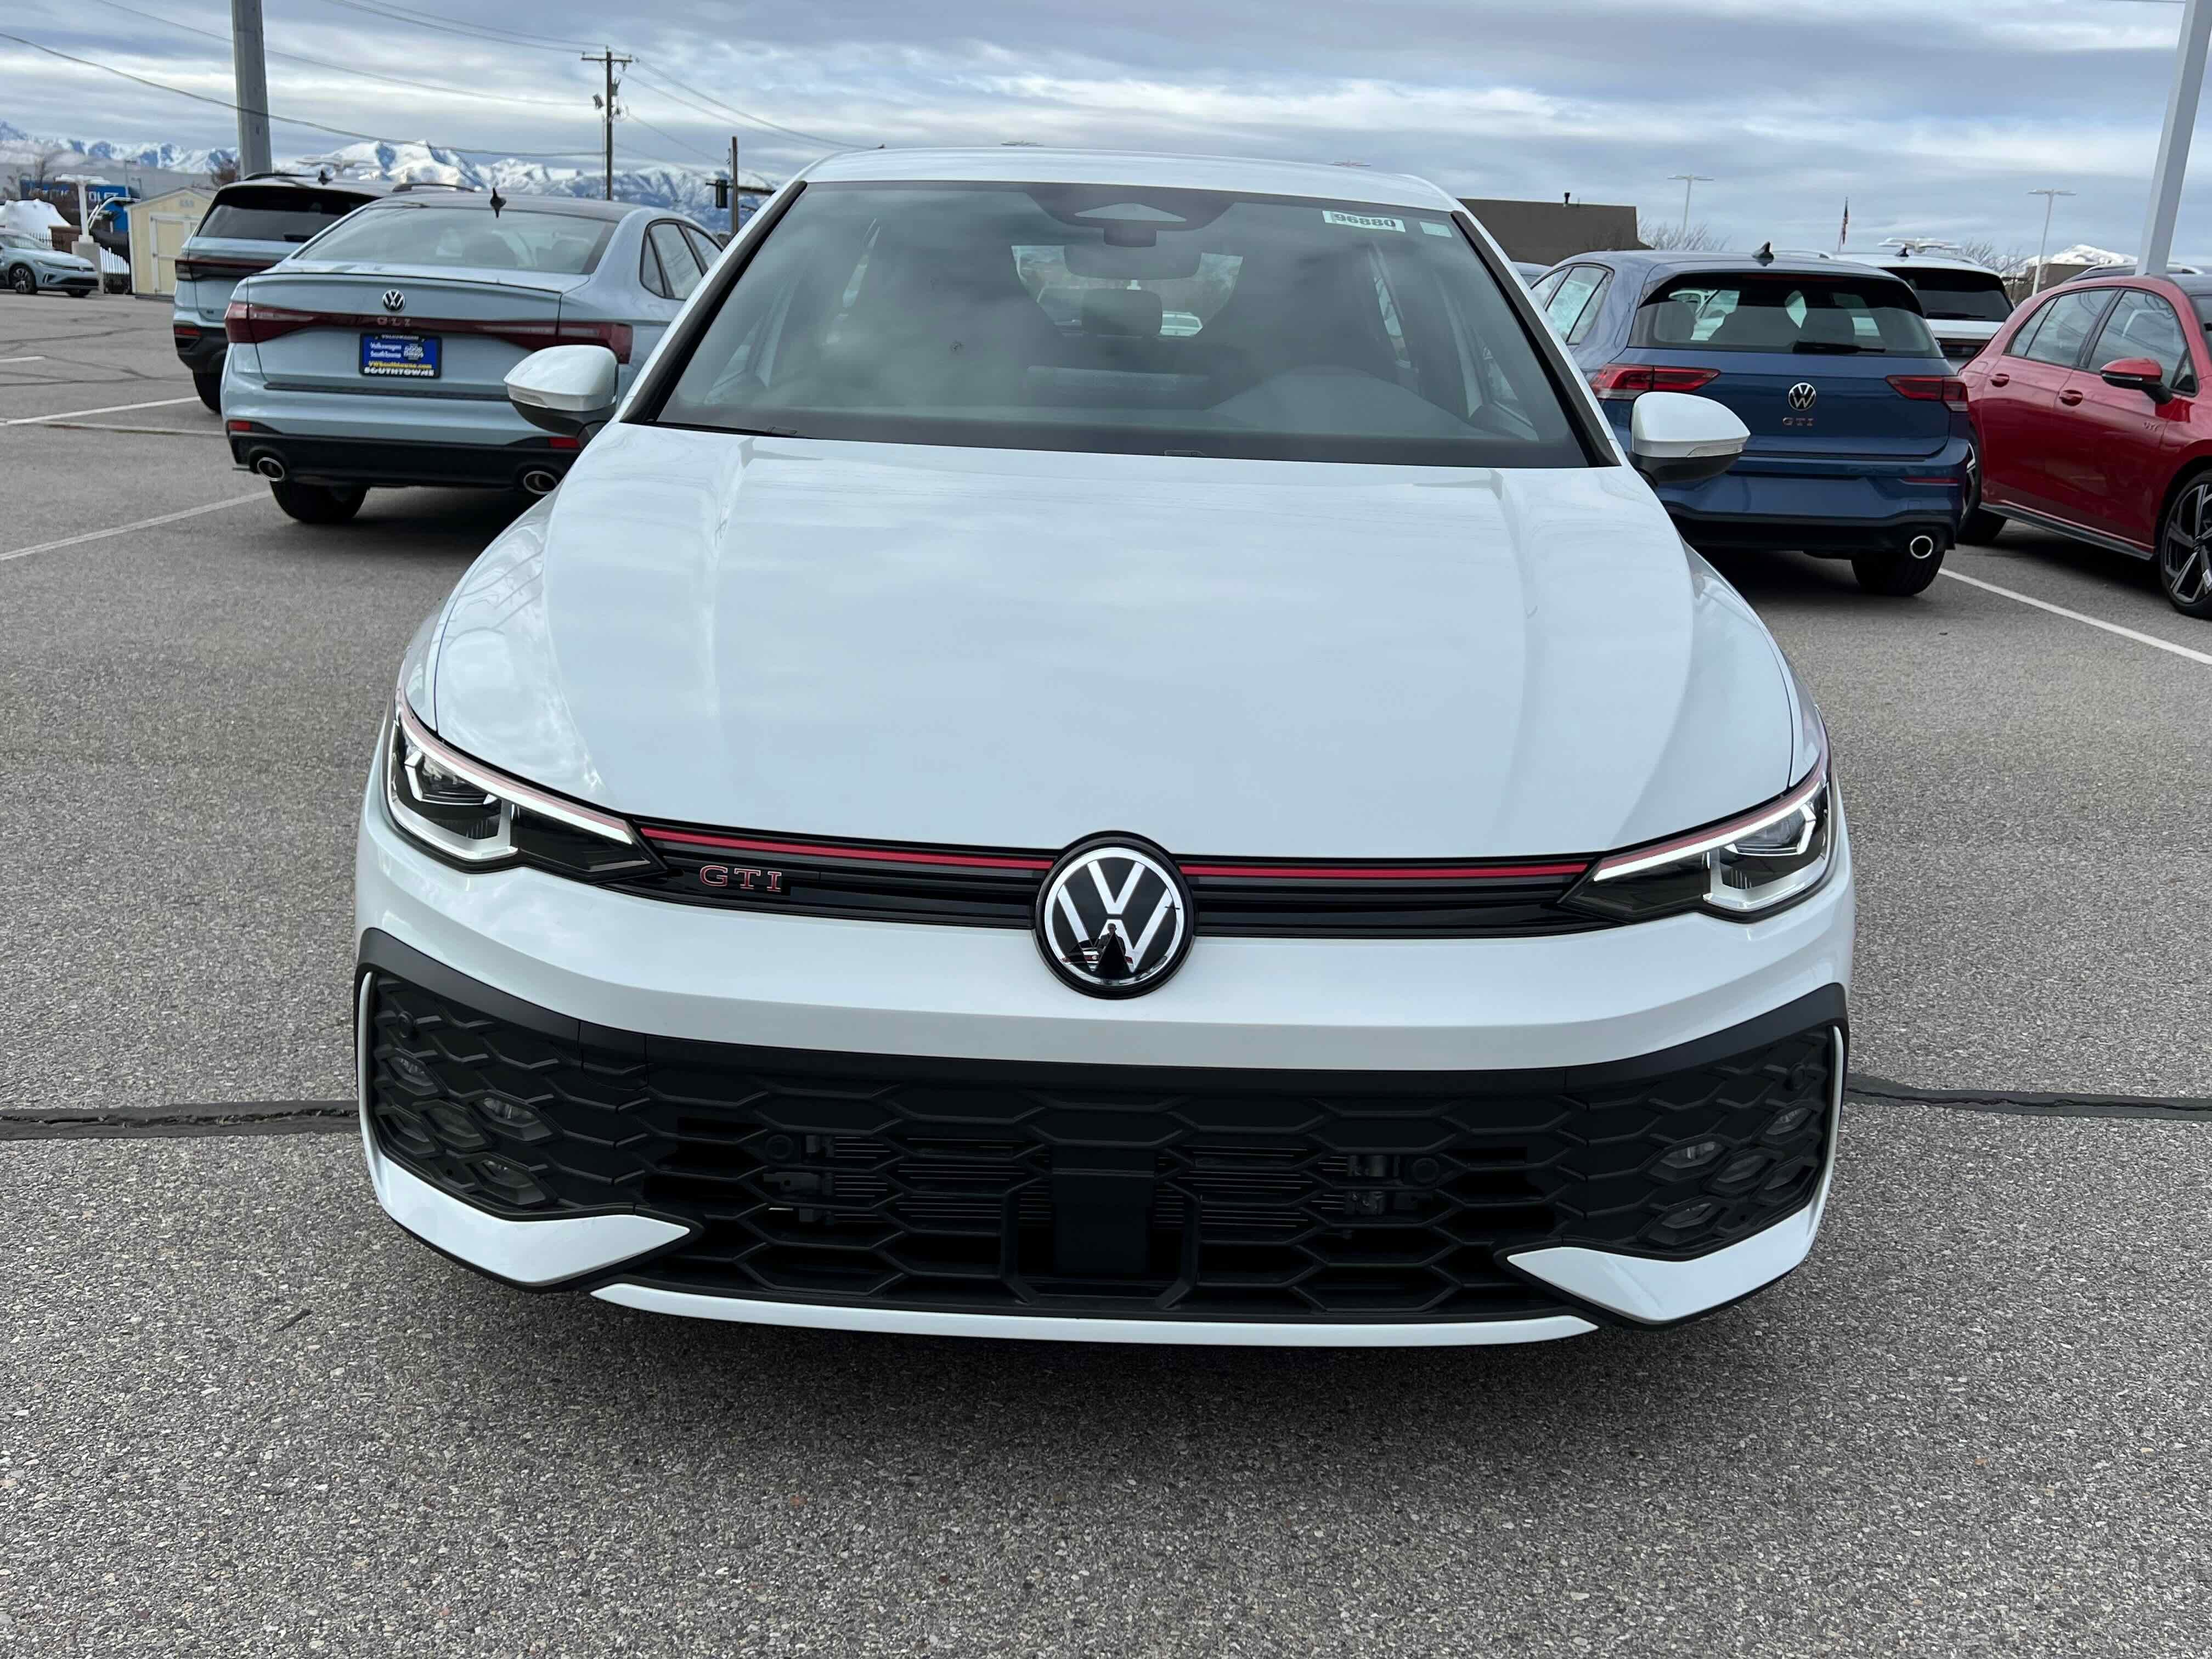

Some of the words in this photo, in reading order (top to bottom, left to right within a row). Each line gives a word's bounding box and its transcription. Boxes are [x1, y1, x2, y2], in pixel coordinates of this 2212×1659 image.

[1334, 213, 1396, 227] 96880
[1788, 382, 1816, 411] VW
[1782, 417, 1814, 426] GTI
[699, 865, 782, 892] GTI
[1044, 847, 1184, 986] VW
